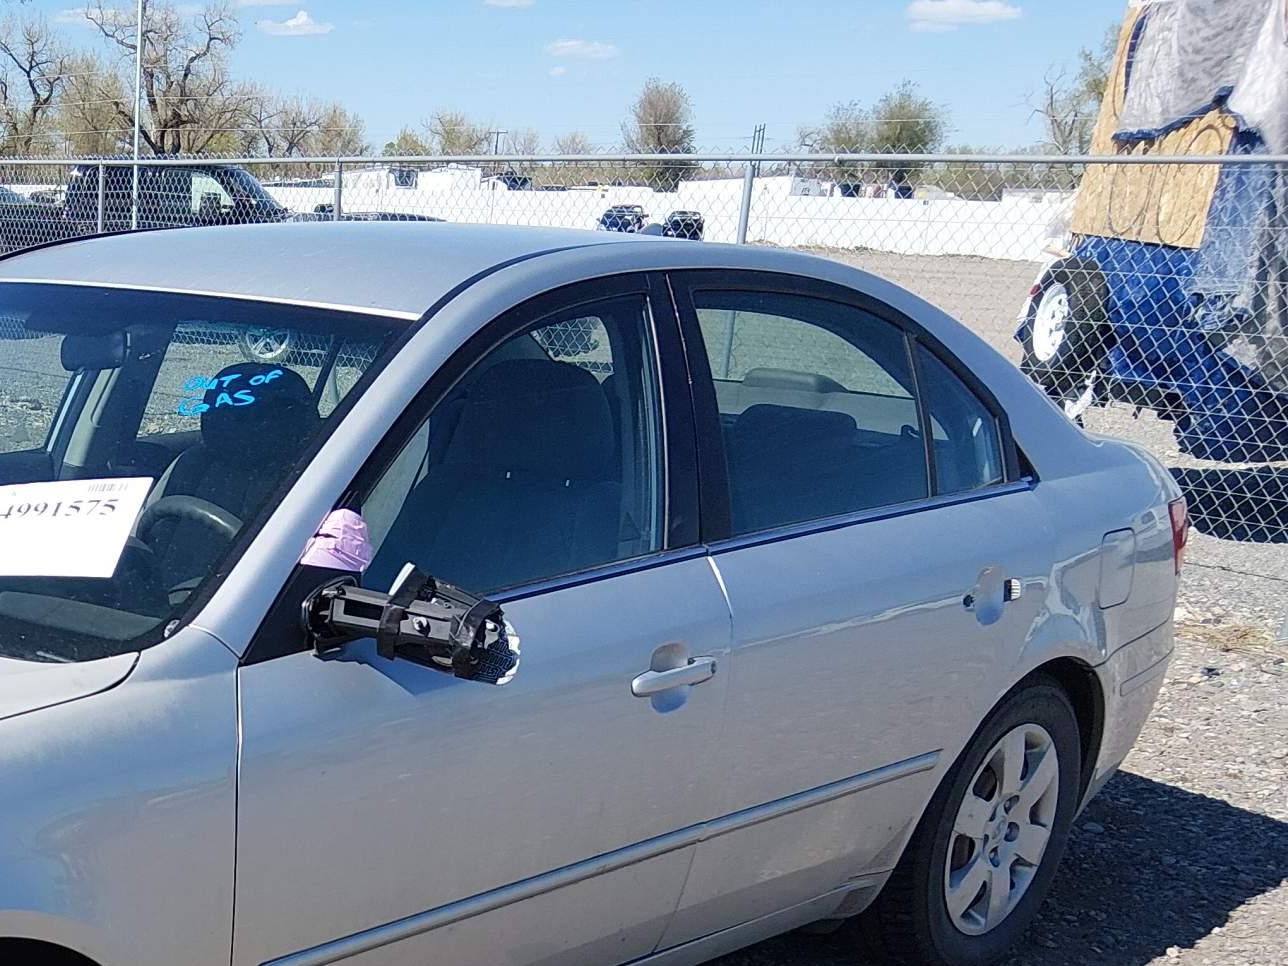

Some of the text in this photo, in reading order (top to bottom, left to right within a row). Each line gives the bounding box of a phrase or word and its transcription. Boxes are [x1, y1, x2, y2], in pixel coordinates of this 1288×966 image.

[183, 369, 284, 391] OUT OF
[177, 389, 256, 417] GAS
